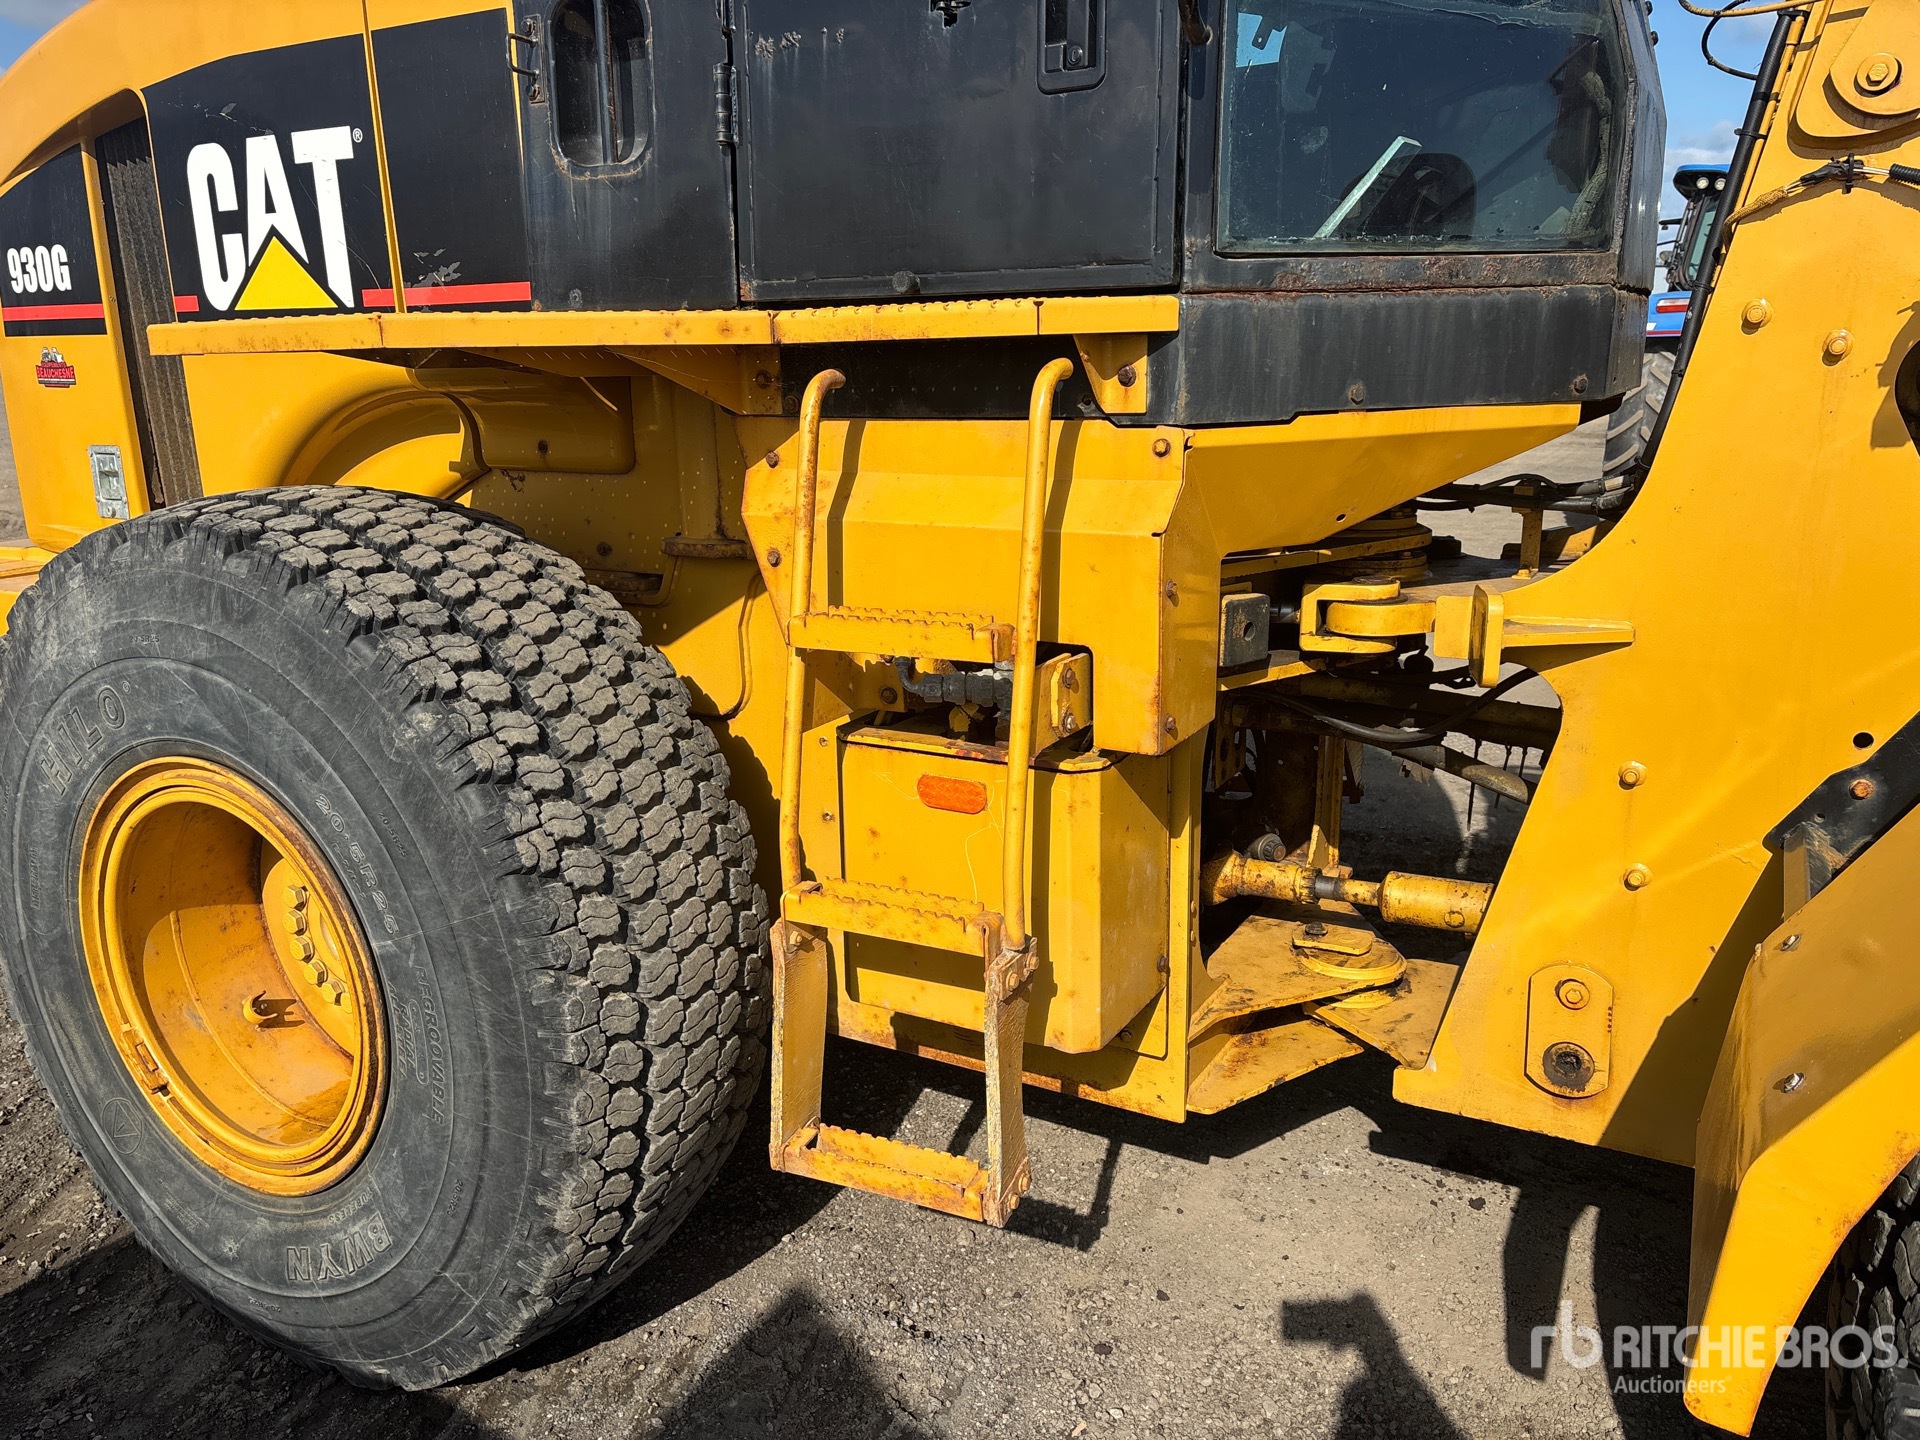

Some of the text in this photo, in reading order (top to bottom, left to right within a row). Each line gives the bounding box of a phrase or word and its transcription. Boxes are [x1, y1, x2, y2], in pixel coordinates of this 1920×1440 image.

[7, 244, 72, 294] 930G
[37, 366, 75, 379] BEAUCHESNE
[40, 685, 126, 797] HILO
[315, 793, 400, 935] 20.5R25
[398, 1002, 417, 1068] RADIAL
[414, 965, 445, 1127] REGROOVABLE
[328, 1186, 373, 1225] TUBELESS
[286, 1211, 393, 1281] BWYN
